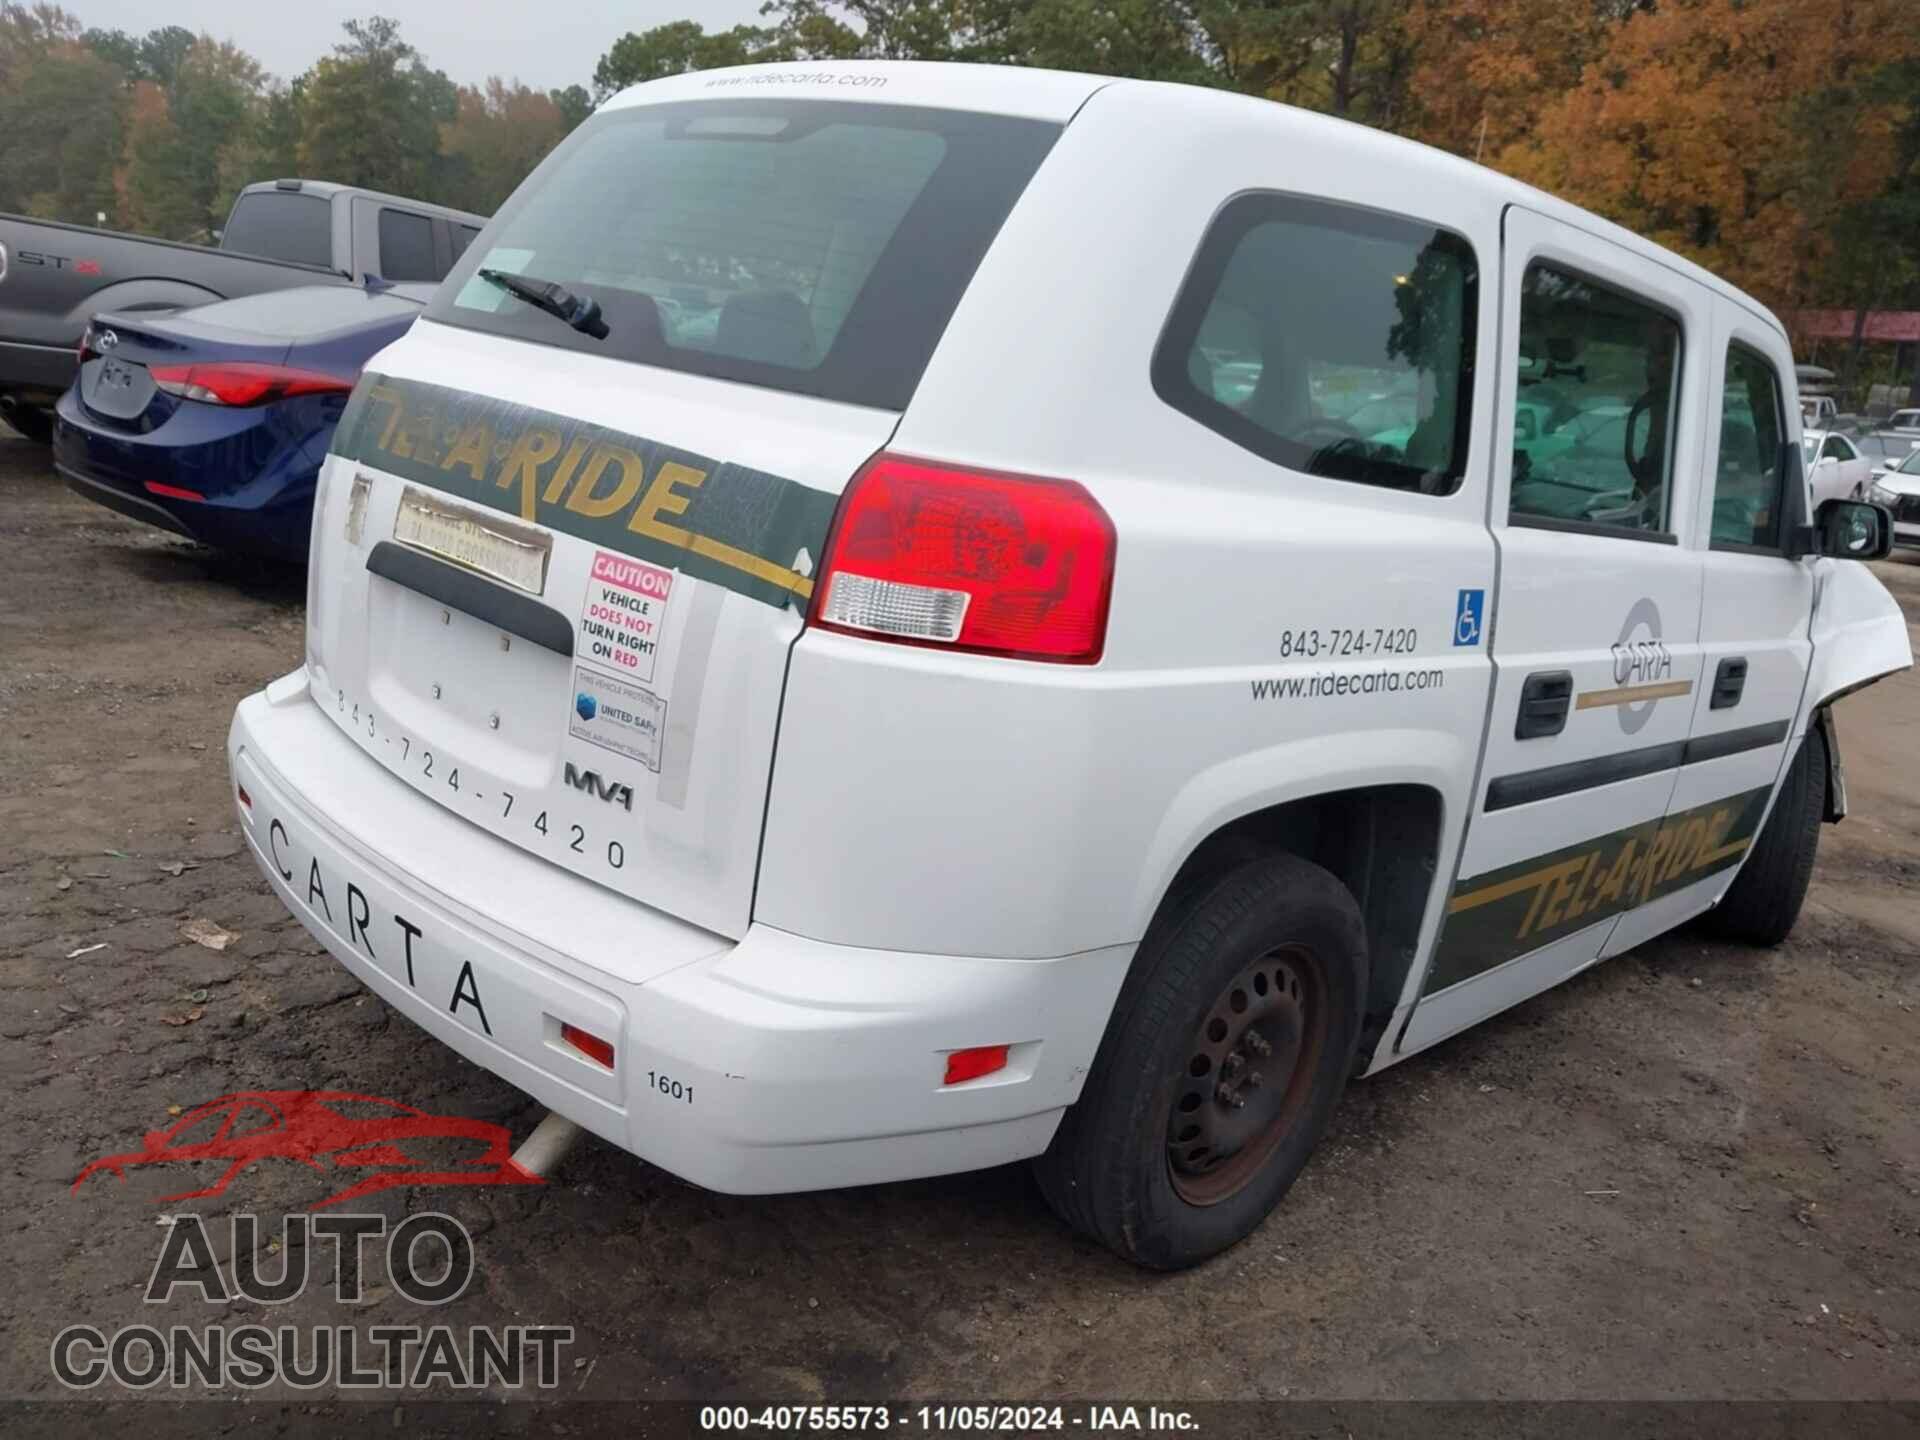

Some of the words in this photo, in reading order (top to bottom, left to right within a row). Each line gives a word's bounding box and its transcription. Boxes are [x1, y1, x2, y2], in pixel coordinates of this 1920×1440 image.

[594, 557, 672, 596] CAUTION
[602, 588, 650, 615] VEHICLE
[590, 604, 623, 624] DOES
[624, 615, 655, 635] NOT
[583, 619, 615, 641] TURN
[617, 632, 656, 655] RIGHT
[1280, 628, 1417, 657] 843-724-7420
[592, 642, 612, 658] ON
[614, 650, 638, 667] RED
[1611, 641, 1672, 684] CARTA
[1251, 669, 1443, 699] www.ridecarta.com
[601, 704, 633, 724] UNITED
[338, 689, 624, 868] 843-724-7420
[269, 818, 493, 1037] CARTA
[647, 1071, 693, 1104] 1601
